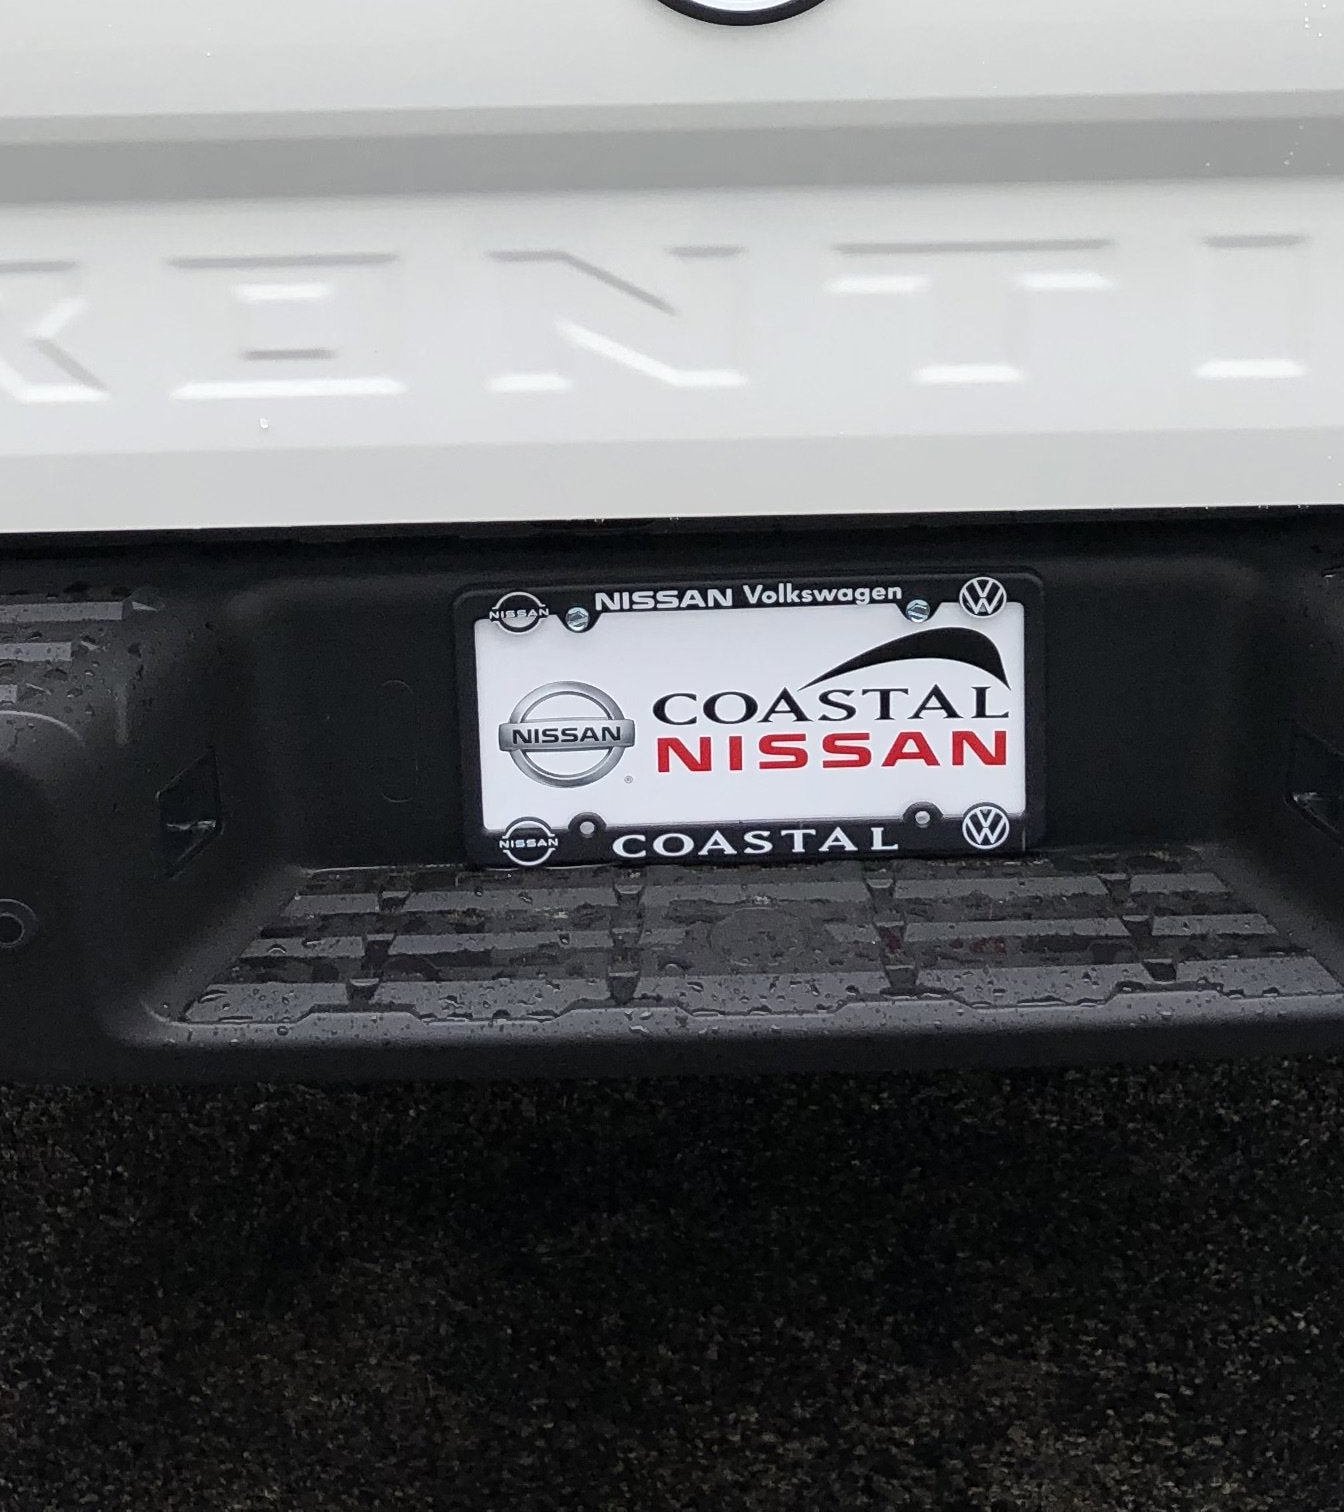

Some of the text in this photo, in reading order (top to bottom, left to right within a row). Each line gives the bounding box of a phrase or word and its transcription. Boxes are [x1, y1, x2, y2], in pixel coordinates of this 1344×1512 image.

[595, 583, 902, 611] NISSAN Volkswagen
[489, 608, 549, 620] NISSAN
[652, 684, 1010, 725] COASTAL
[511, 724, 622, 744] NISSAN
[656, 730, 1007, 774] NISSAN
[499, 838, 559, 849] NISSAN
[612, 825, 898, 859] COASTAL
